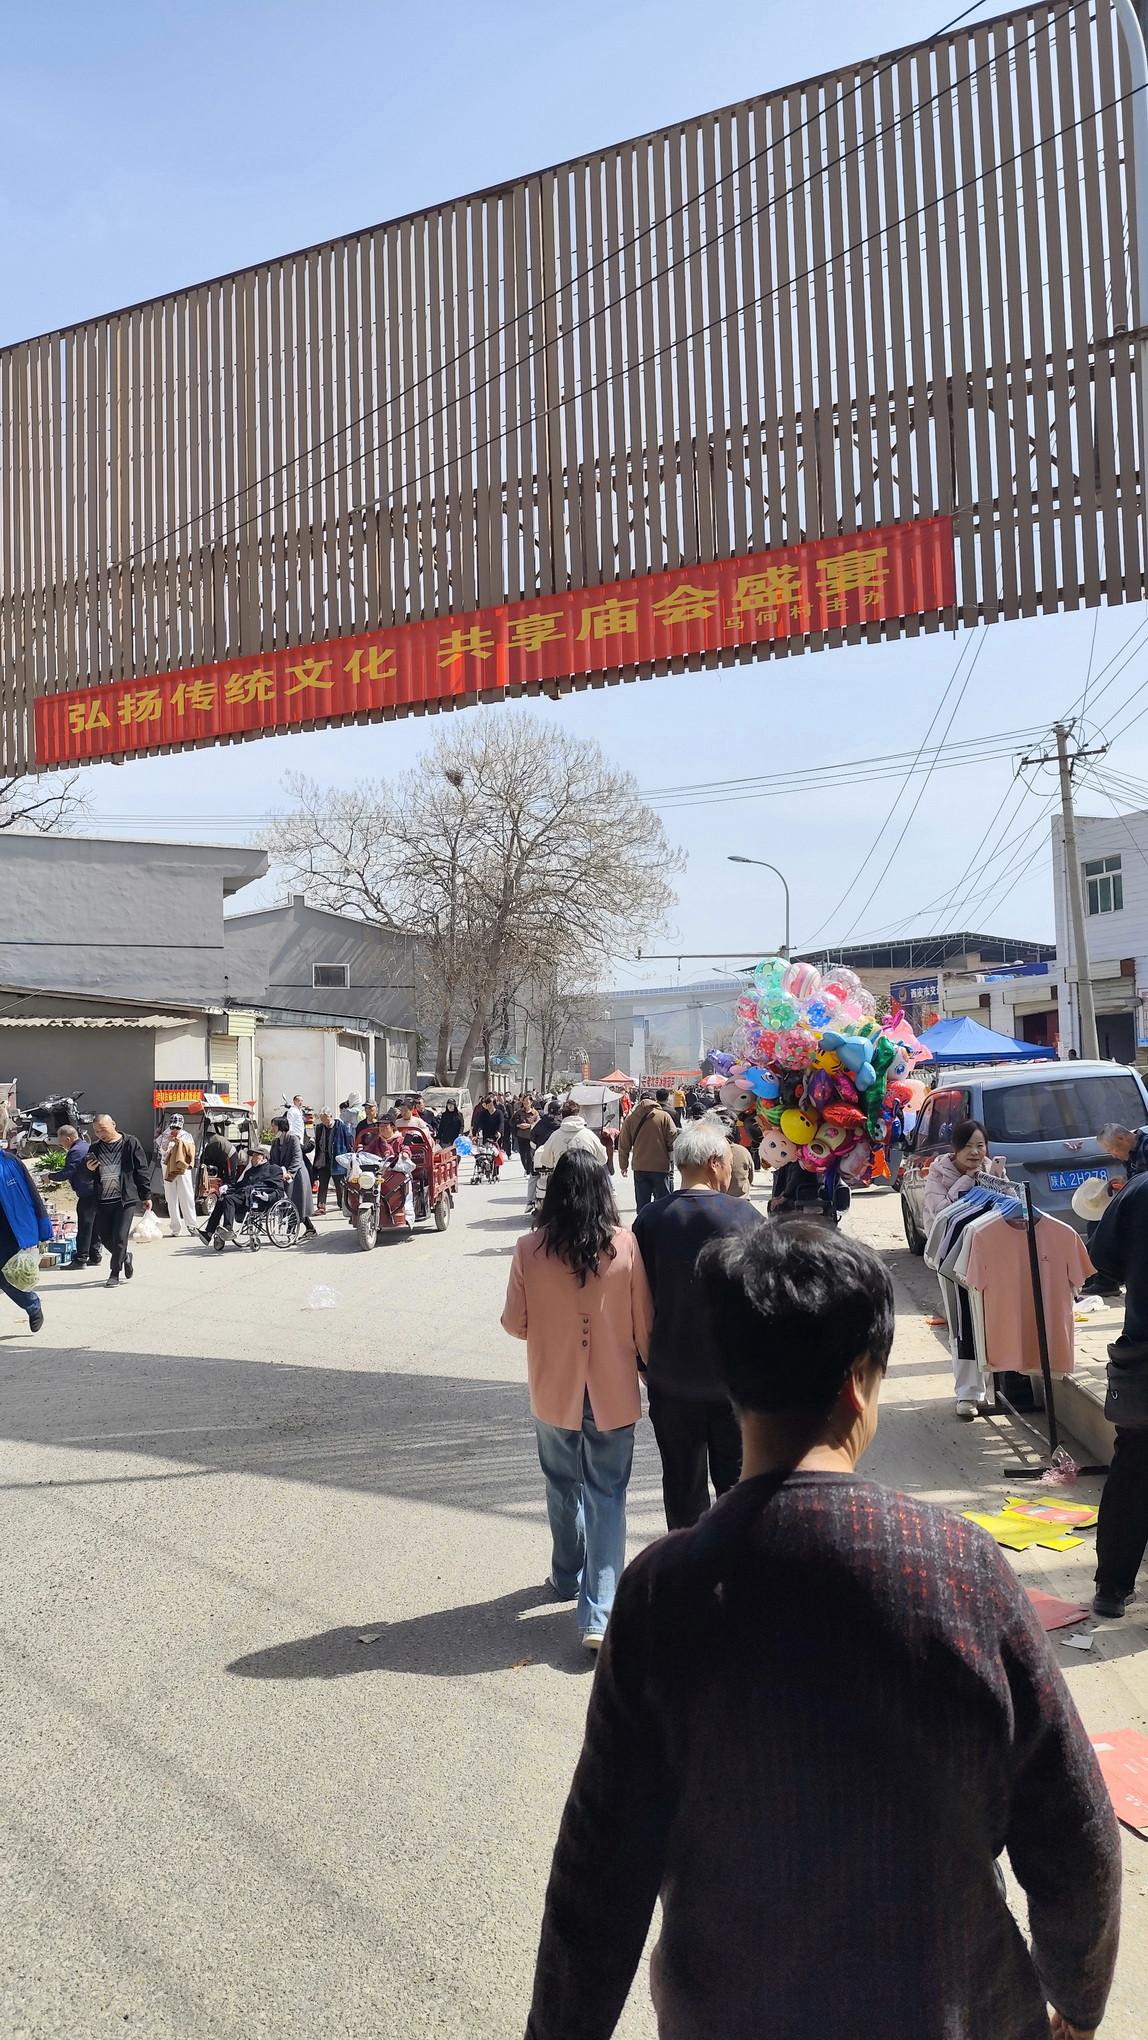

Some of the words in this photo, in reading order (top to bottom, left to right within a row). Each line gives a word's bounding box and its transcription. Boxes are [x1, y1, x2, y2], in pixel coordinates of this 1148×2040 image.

[68, 645, 397, 734] 弘扬传统文化
[437, 547, 889, 668] 共享庙会盛宴
[910, 985, 939, 999] 西安市交
